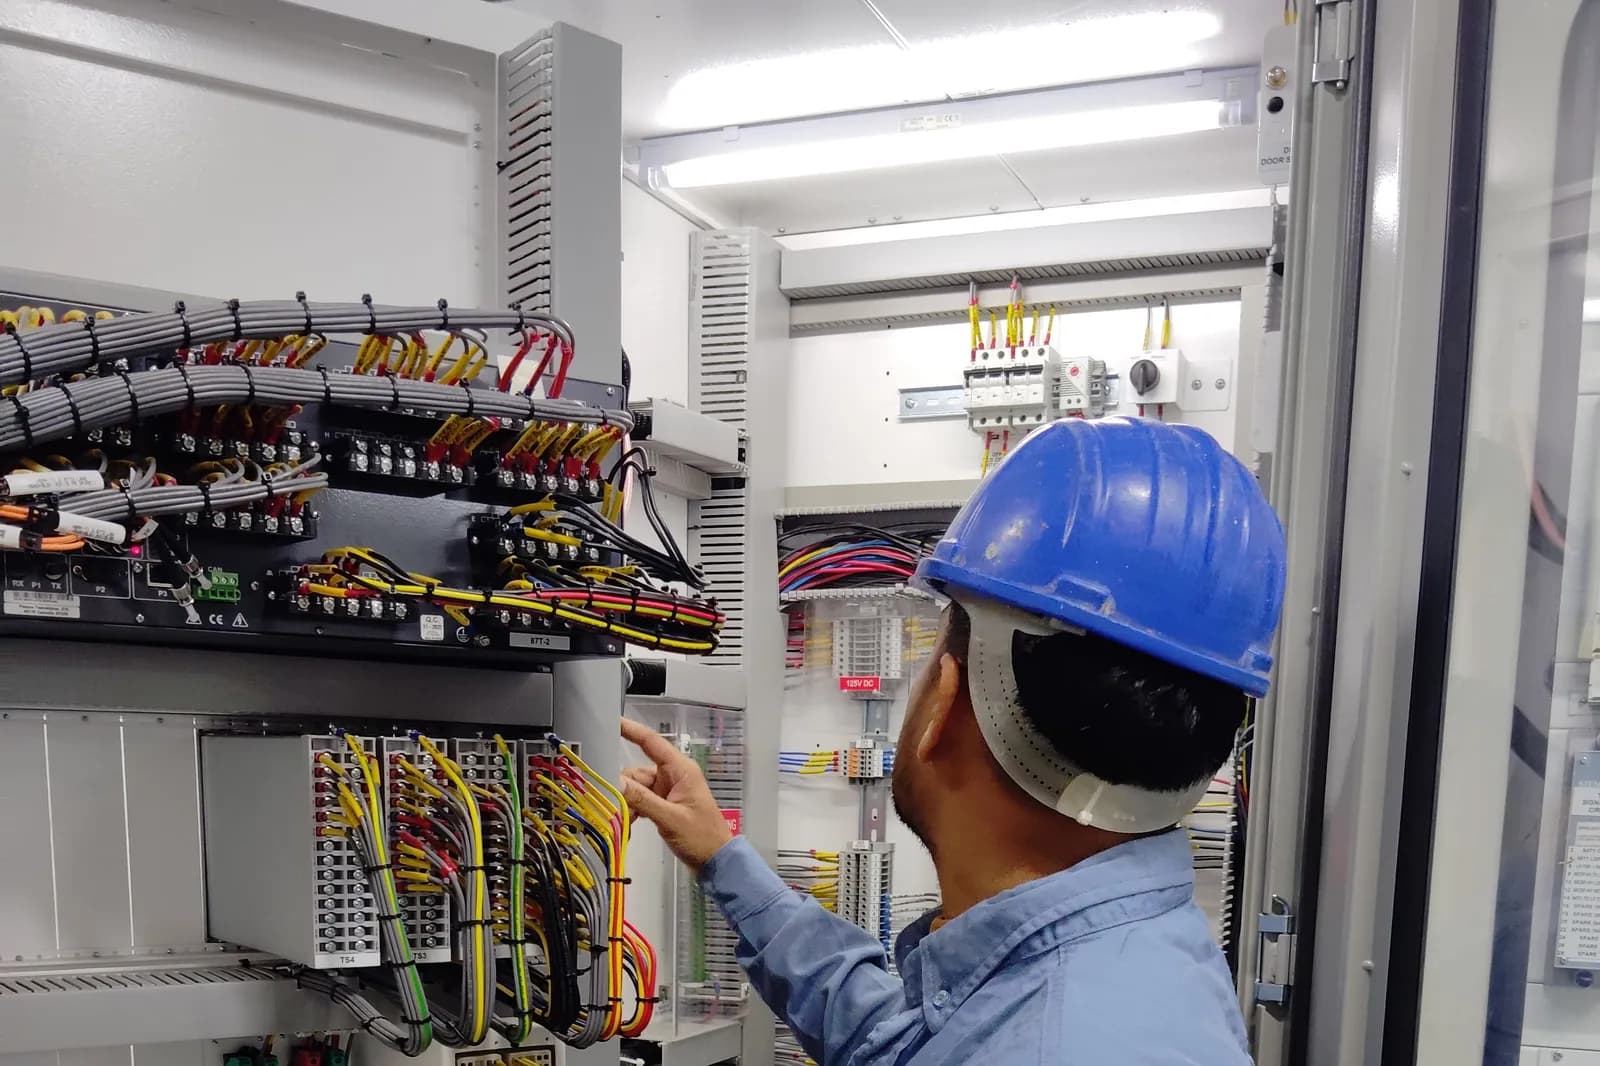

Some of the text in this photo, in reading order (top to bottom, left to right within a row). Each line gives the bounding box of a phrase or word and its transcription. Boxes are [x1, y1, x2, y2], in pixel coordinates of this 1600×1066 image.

[1261, 156, 1284, 166] DOOR
[51, 582, 62, 590] TX
[95, 585, 106, 594] P2
[846, 679, 874, 688] 125V DC
[339, 956, 355, 964] TS4
[413, 952, 427, 960] TS3
